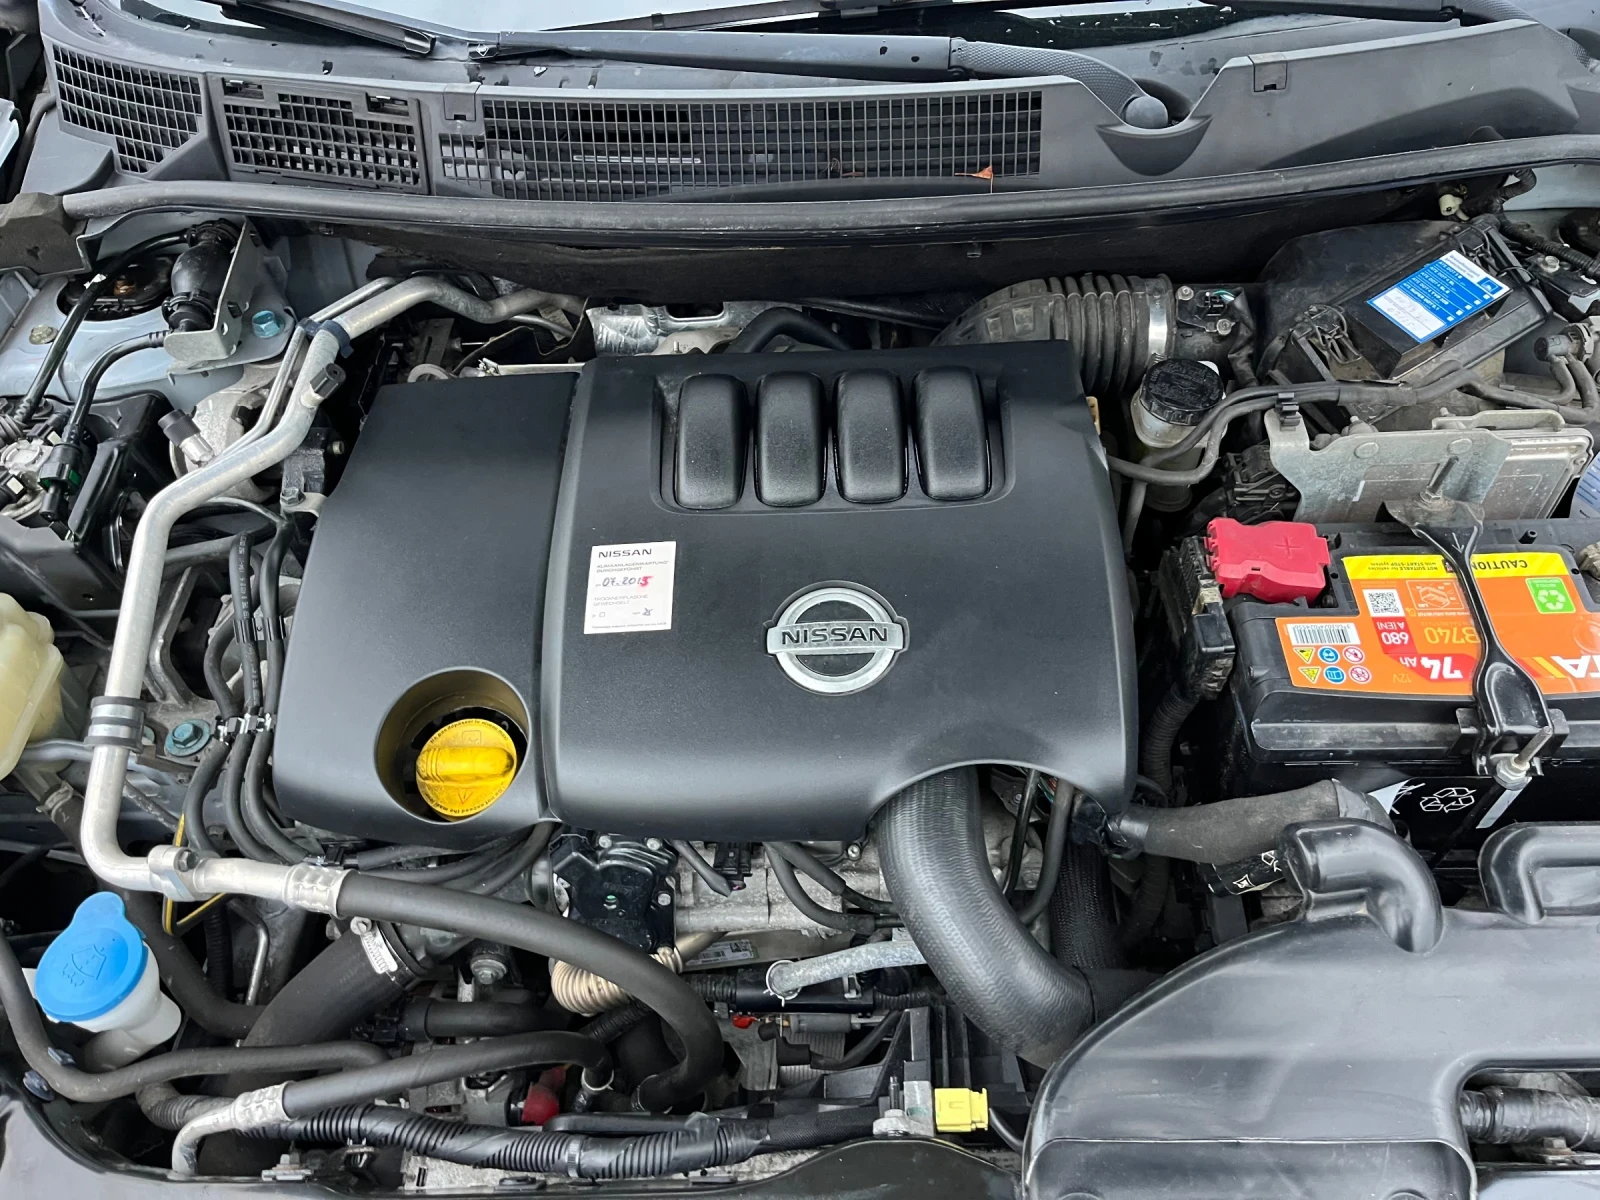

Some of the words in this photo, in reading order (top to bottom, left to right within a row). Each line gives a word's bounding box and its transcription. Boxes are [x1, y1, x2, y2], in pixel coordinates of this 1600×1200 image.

[598, 548, 652, 558] NISSAN
[1397, 622, 1405, 630] A
[781, 627, 888, 645] NISSAN
[1381, 631, 1409, 645] 680
[1400, 656, 1417, 668] Ah
[1420, 656, 1463, 680] 74
[1393, 673, 1412, 684] 12V
